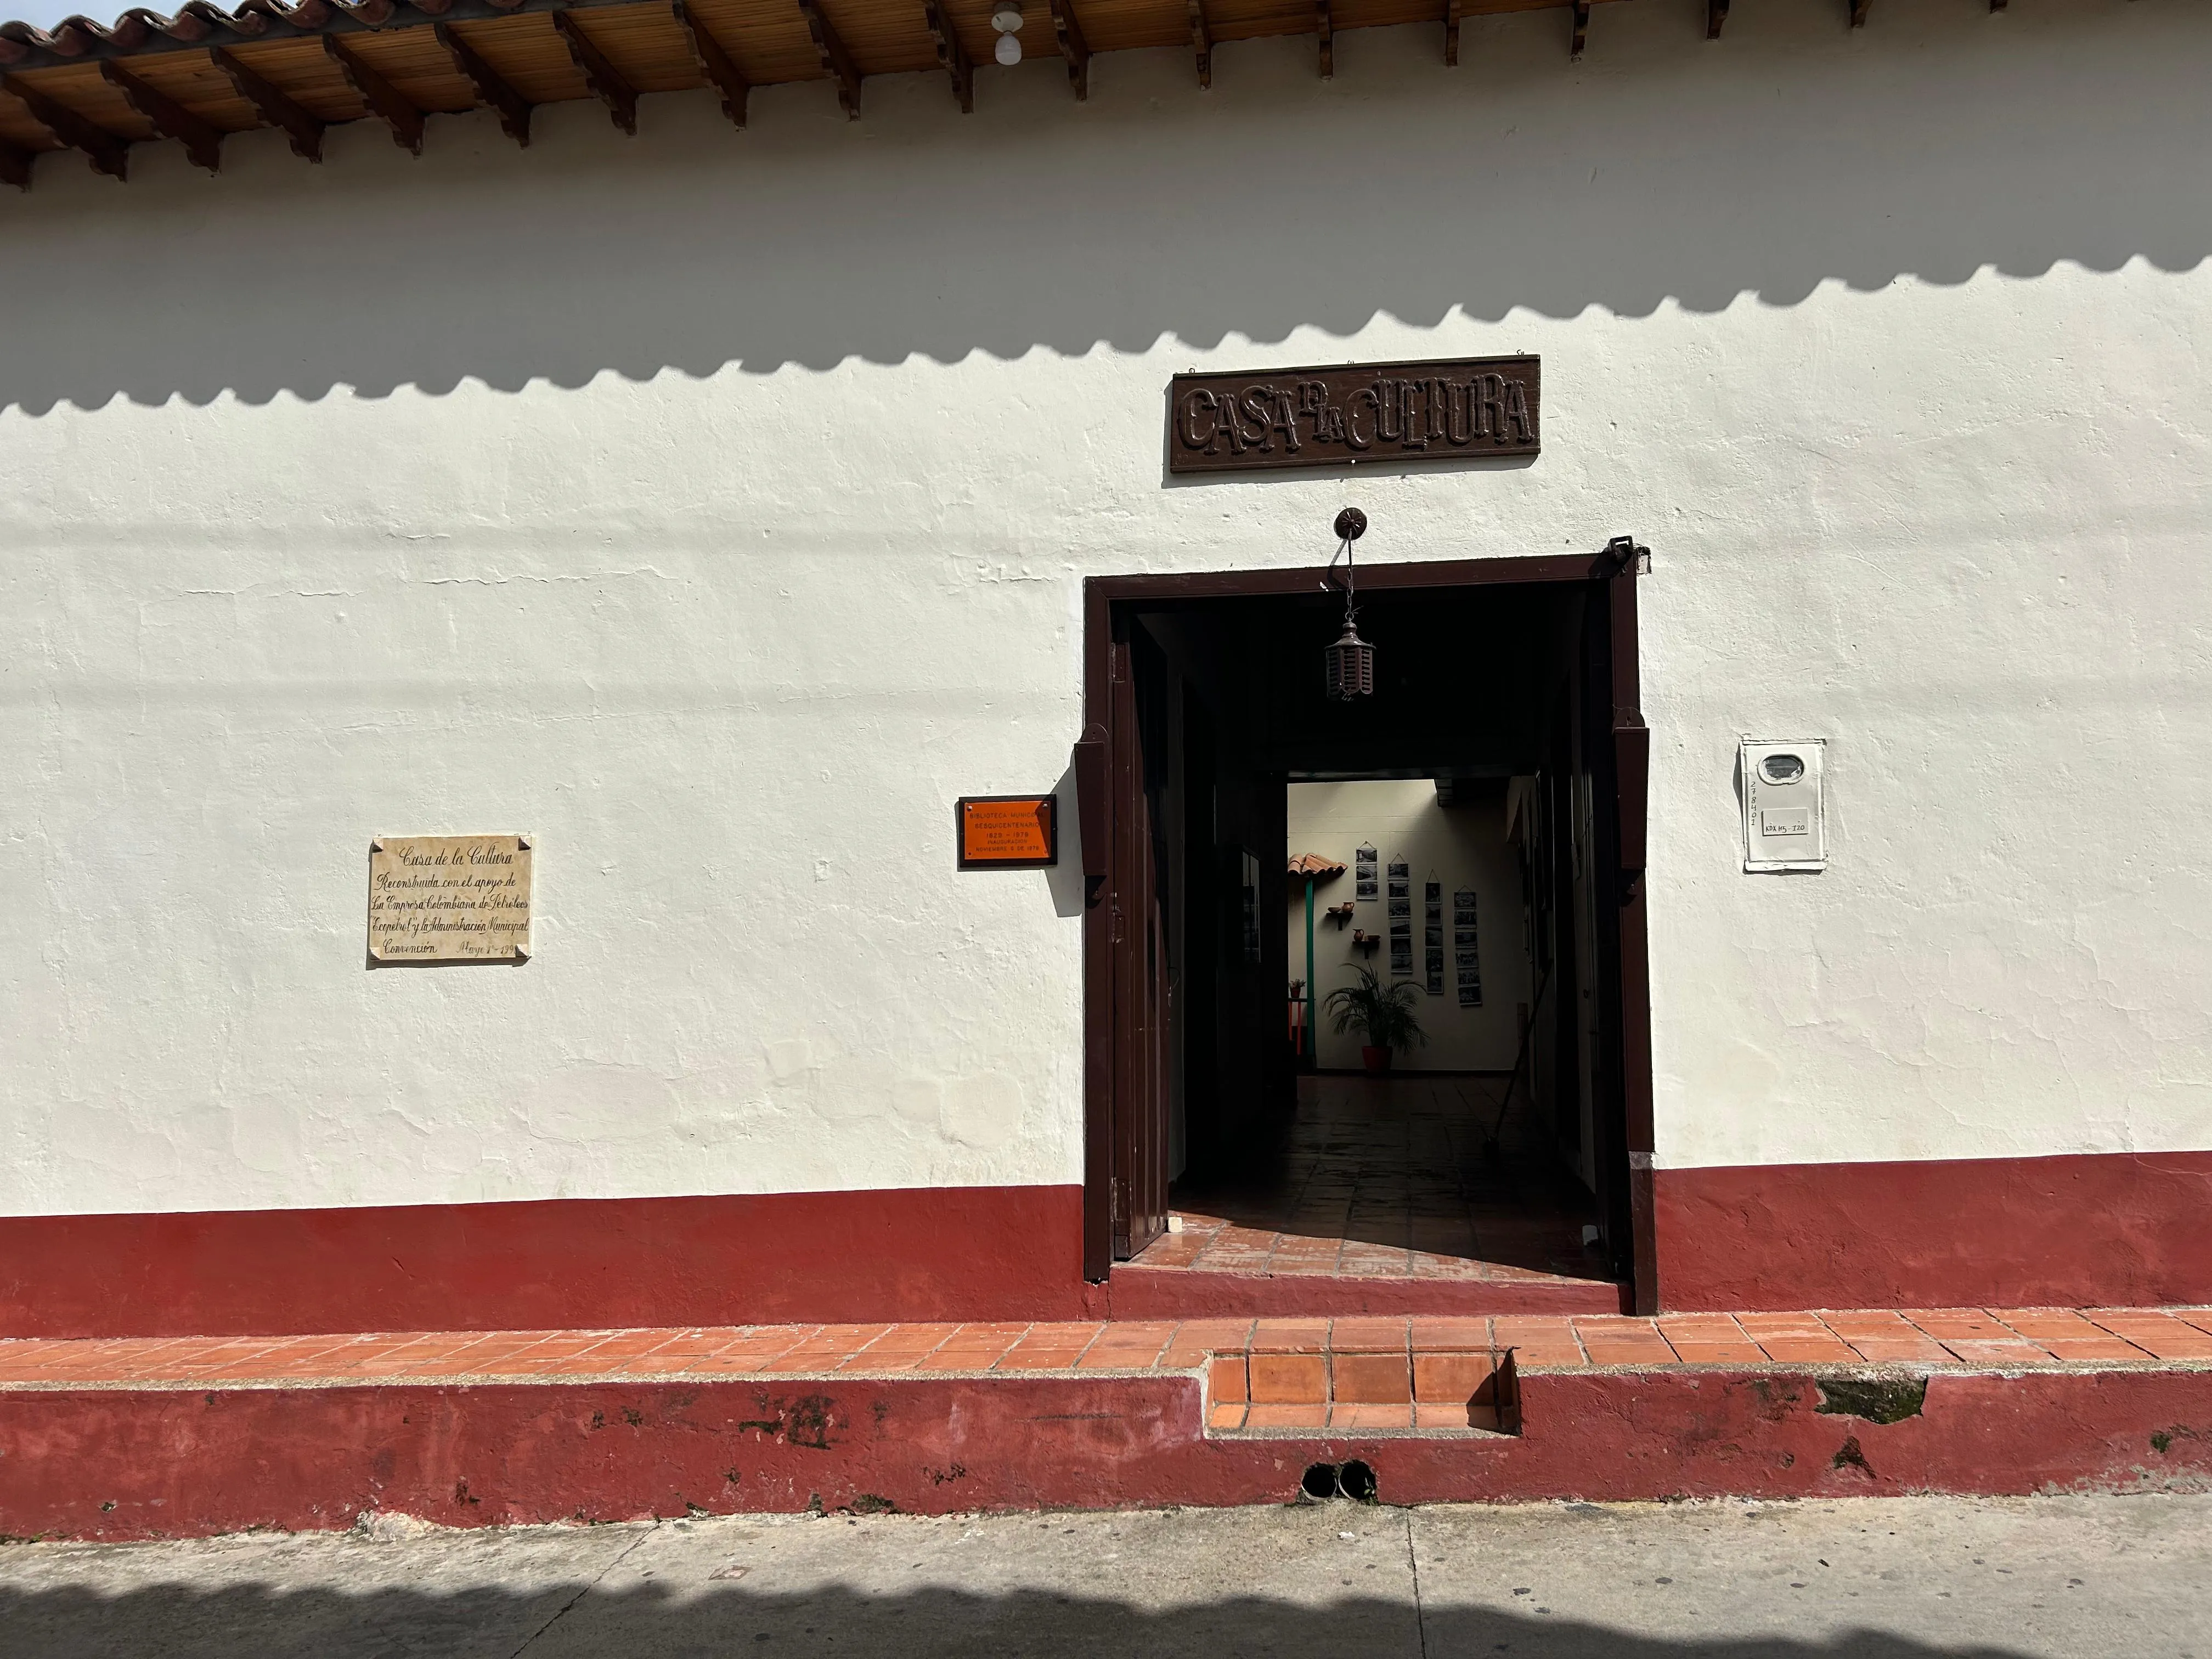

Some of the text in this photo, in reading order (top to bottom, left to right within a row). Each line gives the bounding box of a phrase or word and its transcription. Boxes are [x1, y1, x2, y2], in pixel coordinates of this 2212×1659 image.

[1178, 385, 1301, 454] CASA
[1314, 404, 1345, 442] LA
[1346, 373, 1535, 451] CULTURA
[399, 842, 514, 866] Casa de la Cultura
[374, 871, 516, 895] Reconstruida con el apoyo de
[371, 895, 384, 910] La
[386, 895, 425, 915] Empresa
[425, 895, 476, 910] Colombiana
[478, 896, 488, 909] de
[412, 923, 420, 939] y
[420, 918, 428, 932] la
[424, 917, 486, 934] Administración
[483, 916, 529, 937] Municipal
[383, 939, 437, 954] Convención
